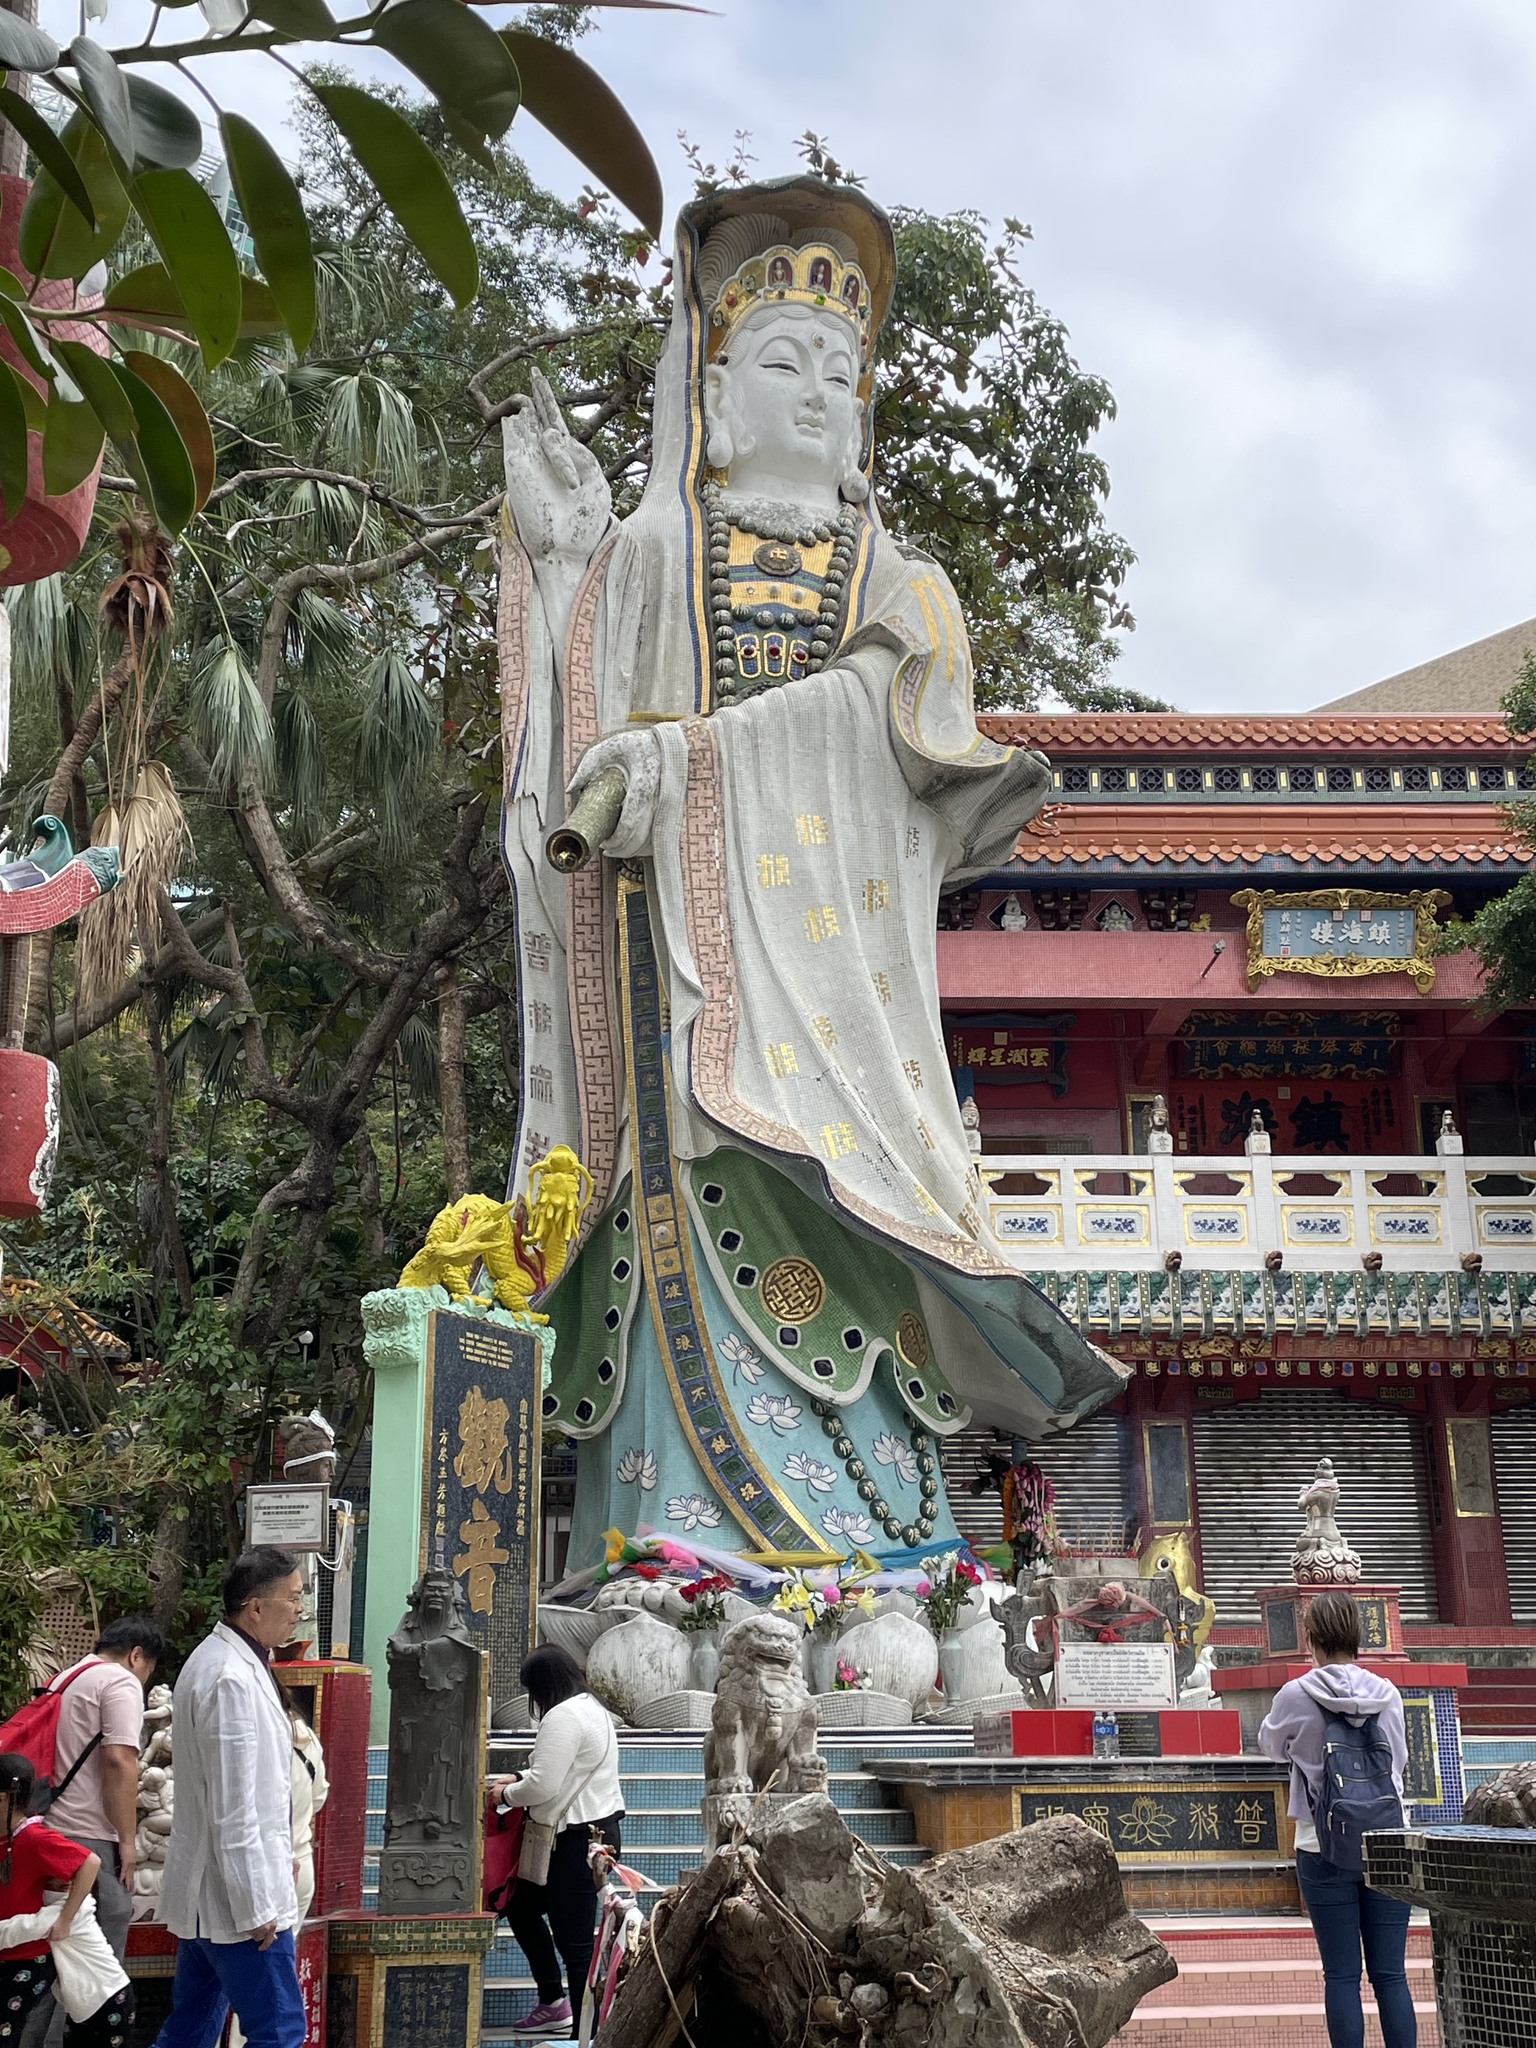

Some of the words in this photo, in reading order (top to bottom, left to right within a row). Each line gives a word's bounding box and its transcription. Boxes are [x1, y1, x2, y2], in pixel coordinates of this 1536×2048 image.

[1310, 919, 1391, 946] 鎮海樓
[453, 1384, 513, 1616] 觀音
